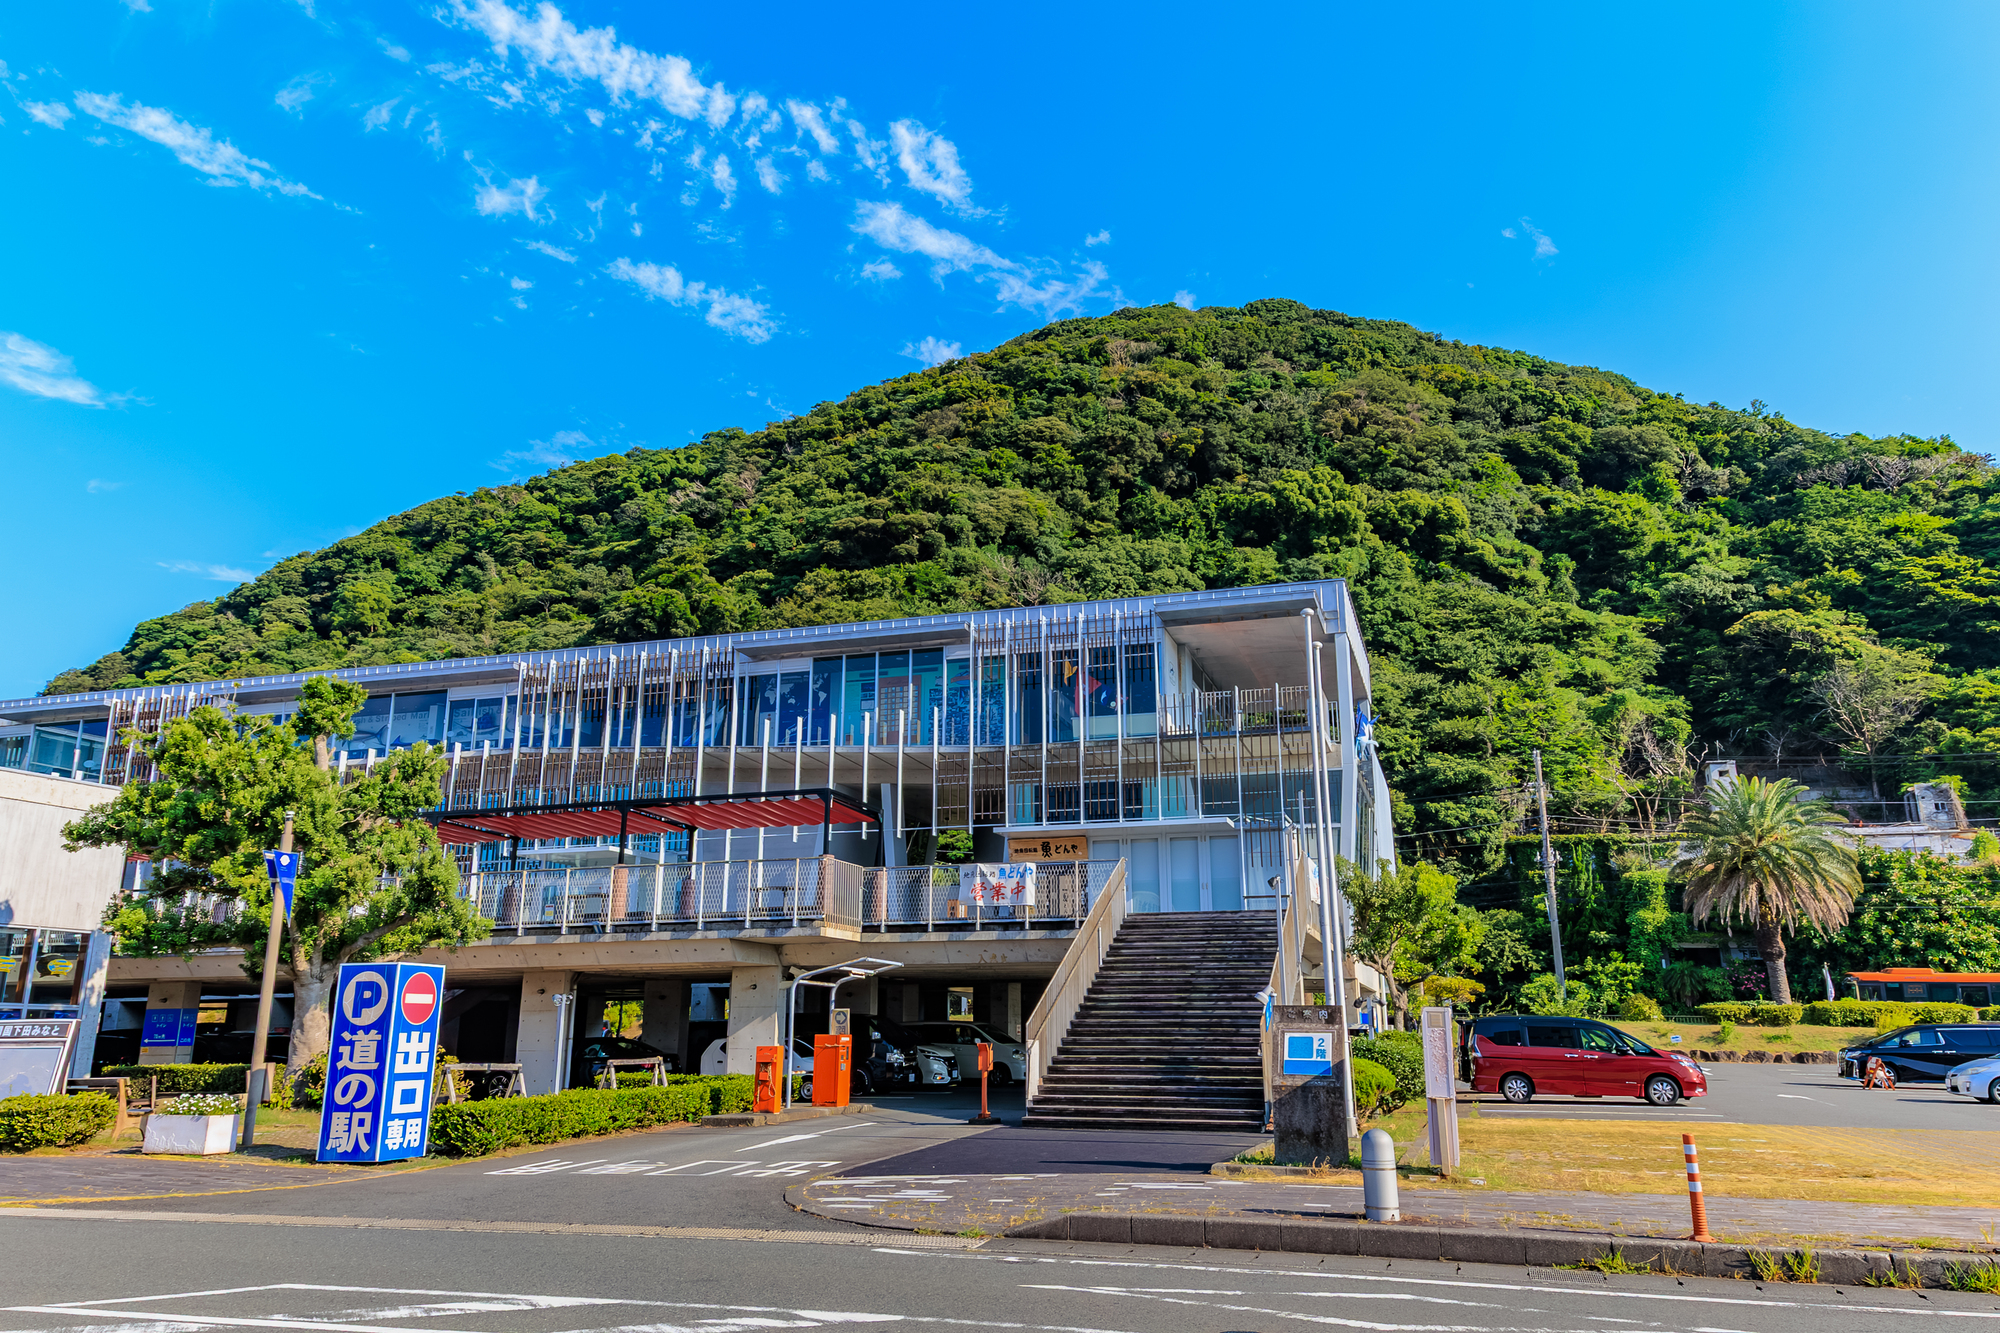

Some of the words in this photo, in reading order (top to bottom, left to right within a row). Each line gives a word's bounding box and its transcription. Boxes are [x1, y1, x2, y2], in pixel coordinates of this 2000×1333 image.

[998, 866, 1034, 880] 魚どんや
[970, 880, 1026, 902] 営業中
[0, 1024, 60, 1037] 国下田みなと
[326, 1029, 382, 1153] 道の駅
[385, 1118, 423, 1151] 専用
